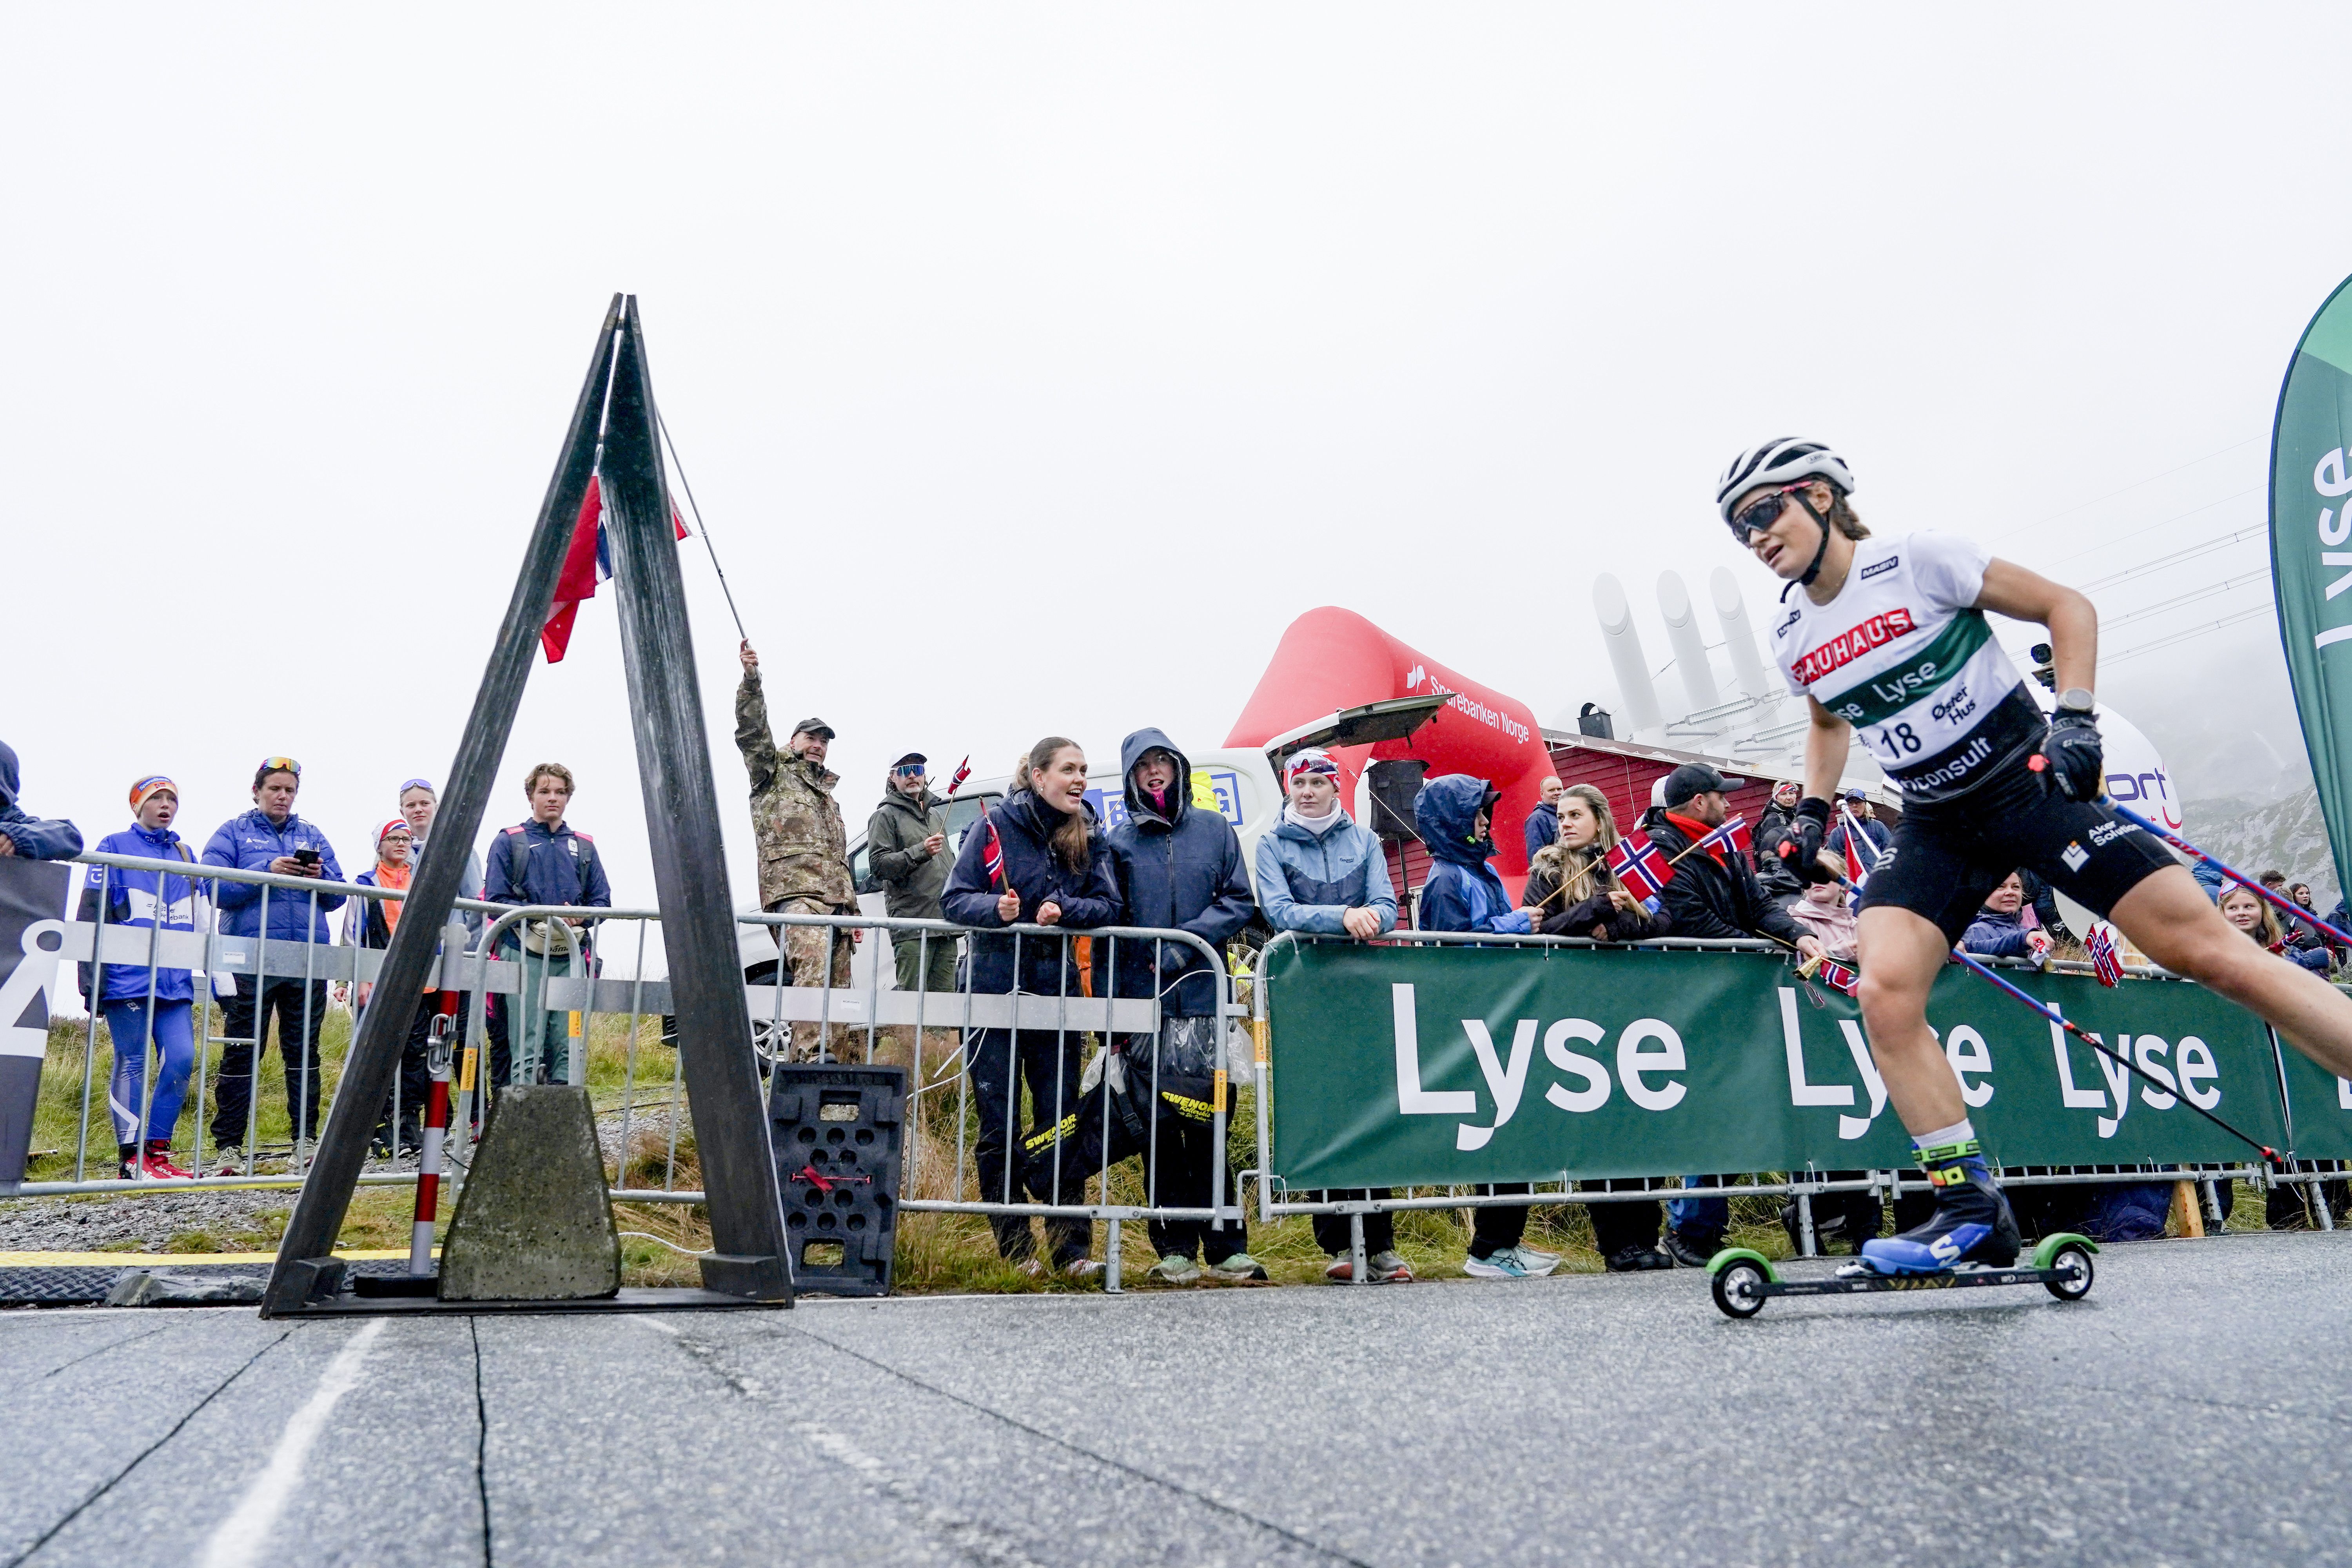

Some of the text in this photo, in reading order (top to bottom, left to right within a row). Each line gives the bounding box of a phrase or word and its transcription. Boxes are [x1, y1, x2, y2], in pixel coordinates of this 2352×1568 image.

[1793, 613, 1909, 683] BAUHAUS
[1872, 662, 1936, 702] Lyse
[1932, 686, 1967, 722] Øster
[1949, 700, 1976, 725] Hus
[1500, 711, 1529, 744] Norge
[1881, 723, 1921, 759] 18
[2089, 820, 2116, 839] Aker
[1392, 982, 1687, 1151] Lyse
[1778, 987, 1994, 1140] Lye
[2047, 1002, 2221, 1138] Lyse
